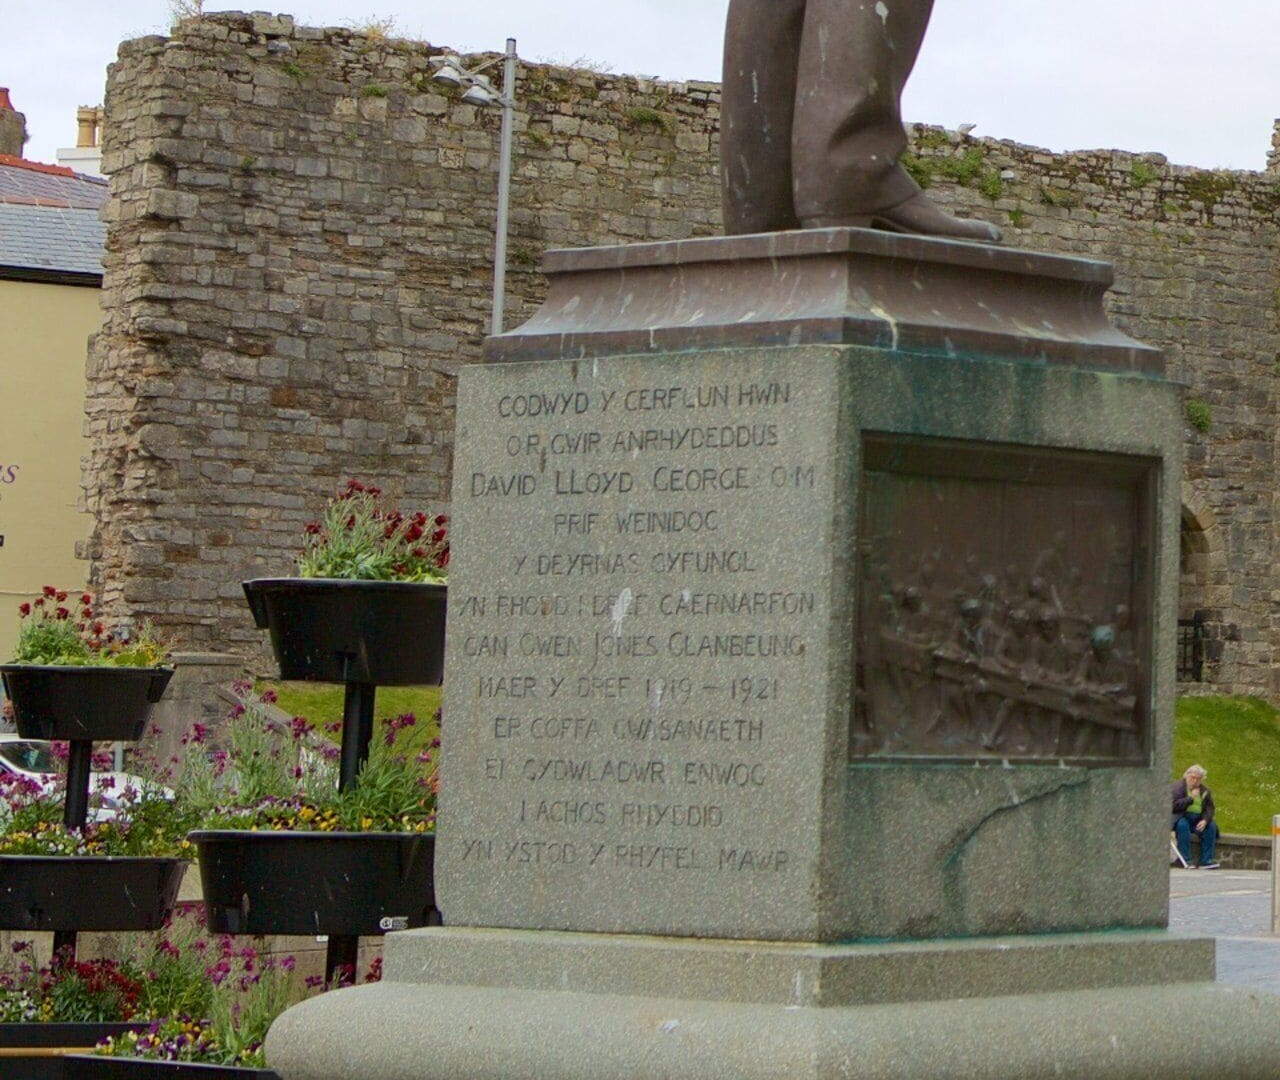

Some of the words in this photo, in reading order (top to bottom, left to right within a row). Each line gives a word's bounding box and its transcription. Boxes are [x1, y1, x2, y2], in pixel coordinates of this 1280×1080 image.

[498, 392, 589, 418] CODWYD
[601, 390, 616, 412] Y
[625, 385, 729, 412] CERFLUN
[738, 382, 790, 406] HWN
[551, 432, 601, 455] GWIR
[612, 424, 778, 452] ANRHYDEDDUS
[470, 472, 537, 498] DAVID
[555, 469, 634, 495] LLOYD
[653, 465, 749, 492] GEORGE
[553, 513, 600, 535] PRIF
[616, 510, 718, 534] WEINIDOG
[513, 555, 528, 576] Y
[659, 592, 815, 617] CAERNARFON
[586, 631, 659, 674] JONES
[477, 675, 538, 698] MAER
[548, 677, 565, 698] Y
[645, 677, 692, 705] 1919
[731, 675, 779, 704] 1921
[535, 800, 606, 825] ACHOS
[462, 838, 493, 861] YN
[505, 840, 576, 865] YSTOD
[590, 843, 605, 865] Y
